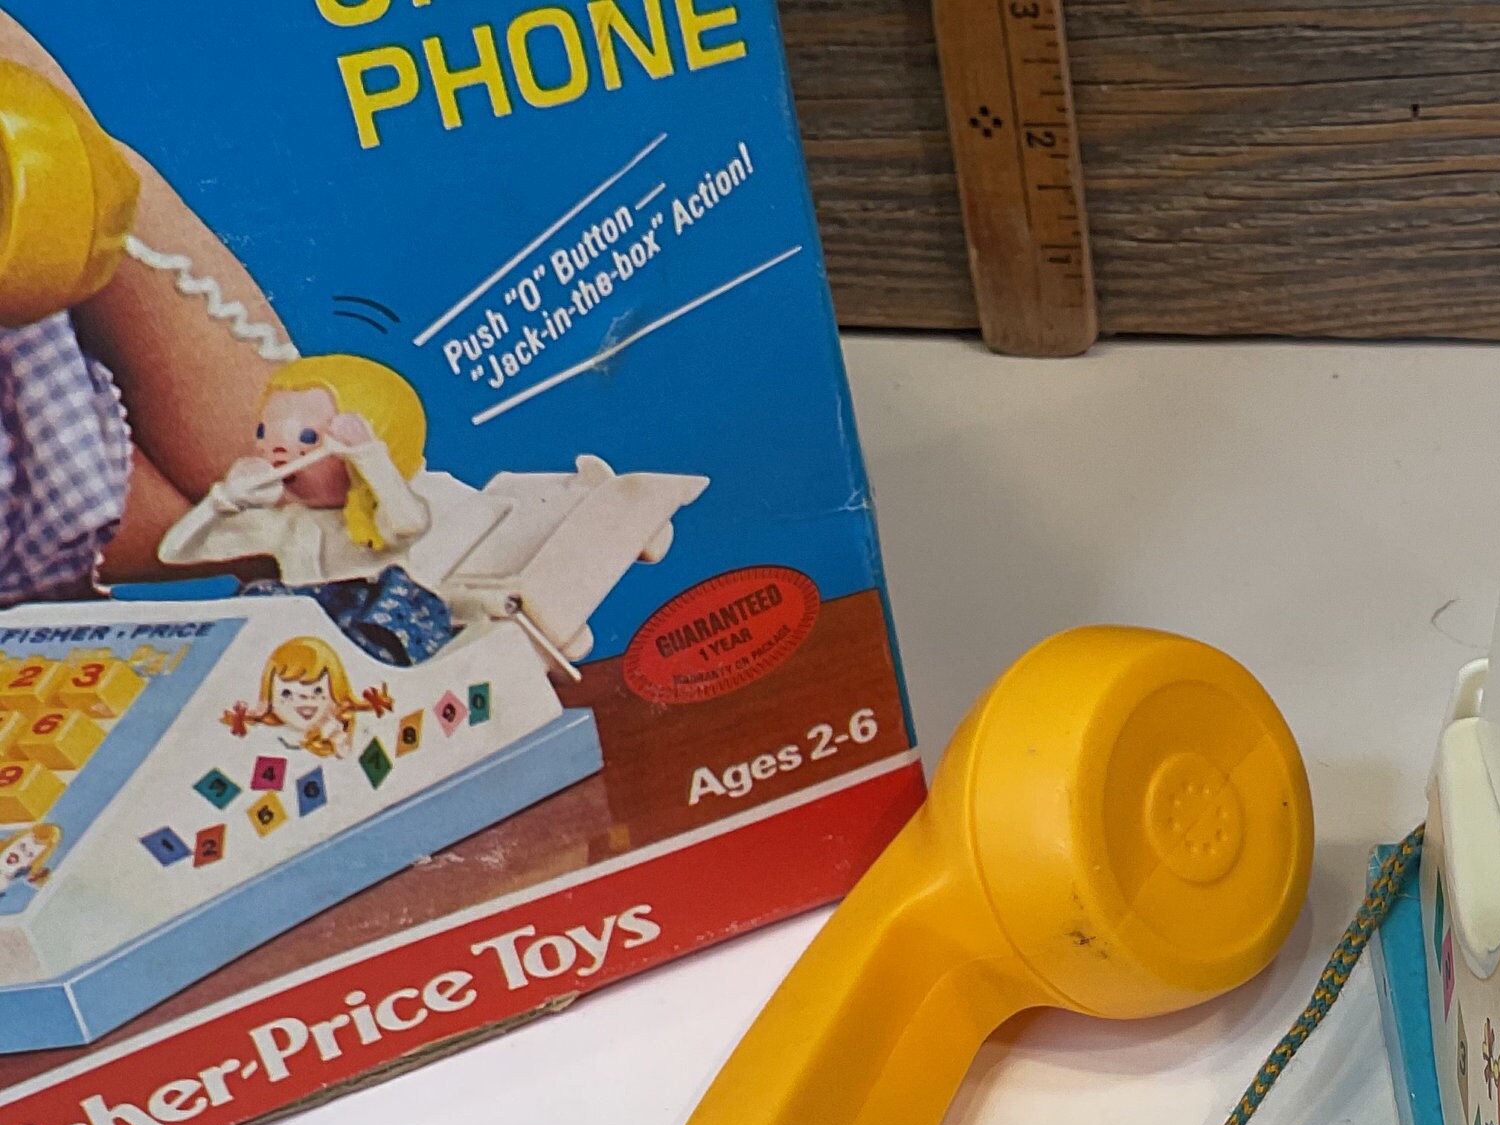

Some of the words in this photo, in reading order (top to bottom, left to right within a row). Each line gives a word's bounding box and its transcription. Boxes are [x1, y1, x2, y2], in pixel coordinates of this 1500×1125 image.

[1011, 1, 1039, 20] 3
[337, 0, 746, 149] PHONE
[1026, 131, 1056, 148] 2
[672, 142, 754, 236] Action!
[443, 309, 509, 375] Push
[551, 205, 634, 285] Button
[1, 625, 110, 644] FISHER
[131, 622, 215, 639] PRICE
[655, 583, 783, 659] GUARANTEED
[709, 627, 753, 658] YEAR
[9, 666, 43, 688] 2
[72, 663, 105, 687] 3
[32, 714, 64, 735] 6
[689, 744, 802, 806] Ages
[807, 708, 878, 761] 2-6
[471, 903, 661, 992] Toys
